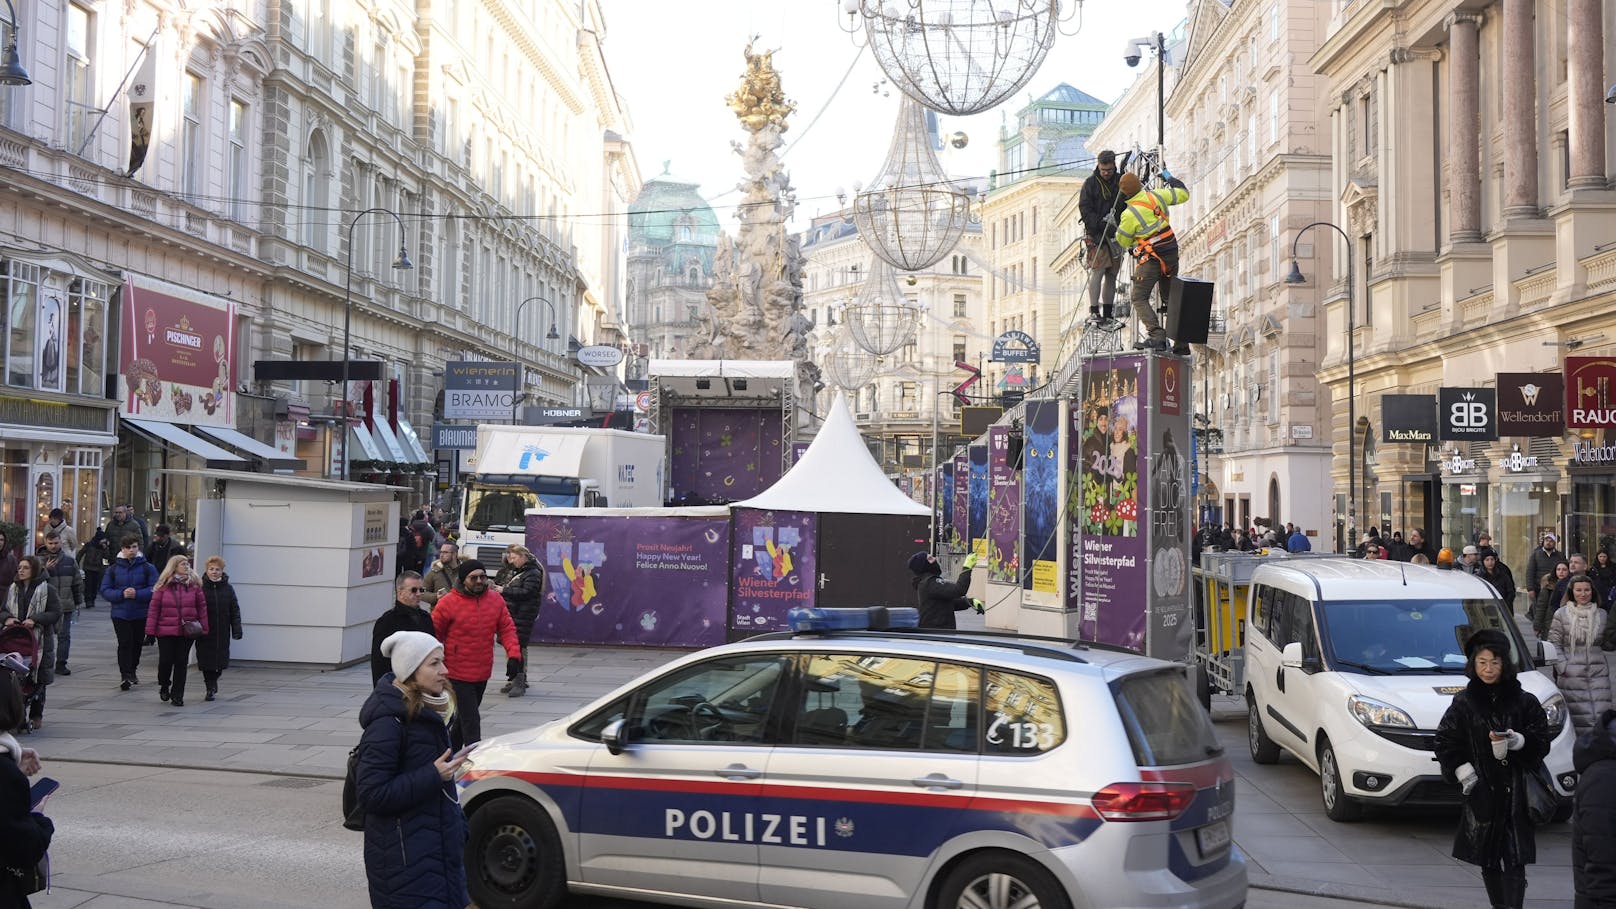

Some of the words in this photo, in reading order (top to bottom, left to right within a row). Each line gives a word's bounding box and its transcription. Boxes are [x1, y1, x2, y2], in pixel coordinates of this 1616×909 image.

[166, 330, 201, 347] PISCHINGER
[453, 367, 515, 376] wienerin
[1500, 411, 1561, 423] Wellendorff
[1389, 430, 1431, 440] MaxMara
[1573, 439, 1616, 462] Wellendor
[660, 544, 693, 553] Neujahr!
[1084, 540, 1113, 551] Wiener
[636, 552, 661, 561] Happy
[662, 553, 680, 561] New
[636, 561, 658, 569] Felice
[658, 562, 679, 570] Anno
[680, 563, 708, 571] Nuovo!
[738, 576, 778, 587] Wiener
[738, 588, 811, 600] Silvesterpfad
[1163, 614, 1178, 627] 2025
[1008, 722, 1054, 751] 133
[665, 808, 826, 846] POLIZEI
